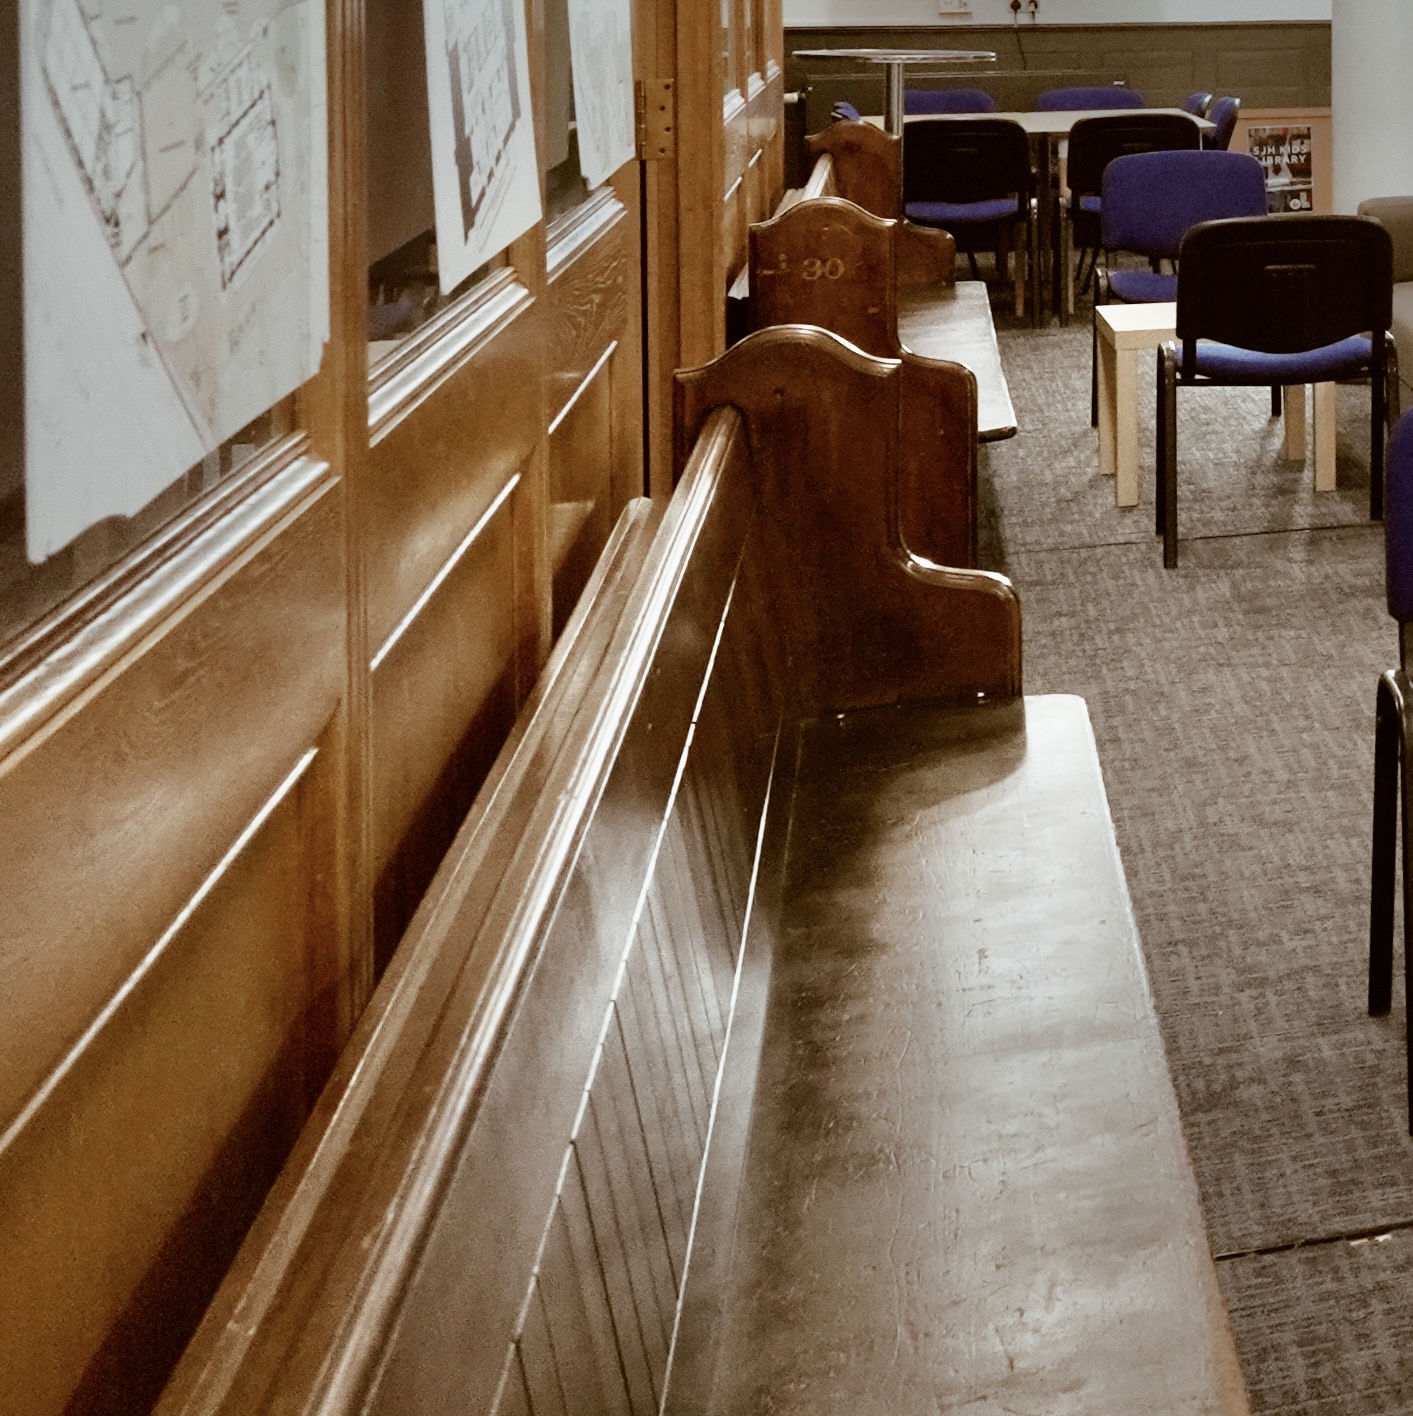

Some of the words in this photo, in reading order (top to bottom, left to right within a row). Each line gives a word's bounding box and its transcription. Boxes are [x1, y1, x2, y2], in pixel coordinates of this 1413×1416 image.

[1252, 146, 1276, 156] SJH
[1279, 144, 1308, 155] KIDS
[803, 258, 845, 280] 30
